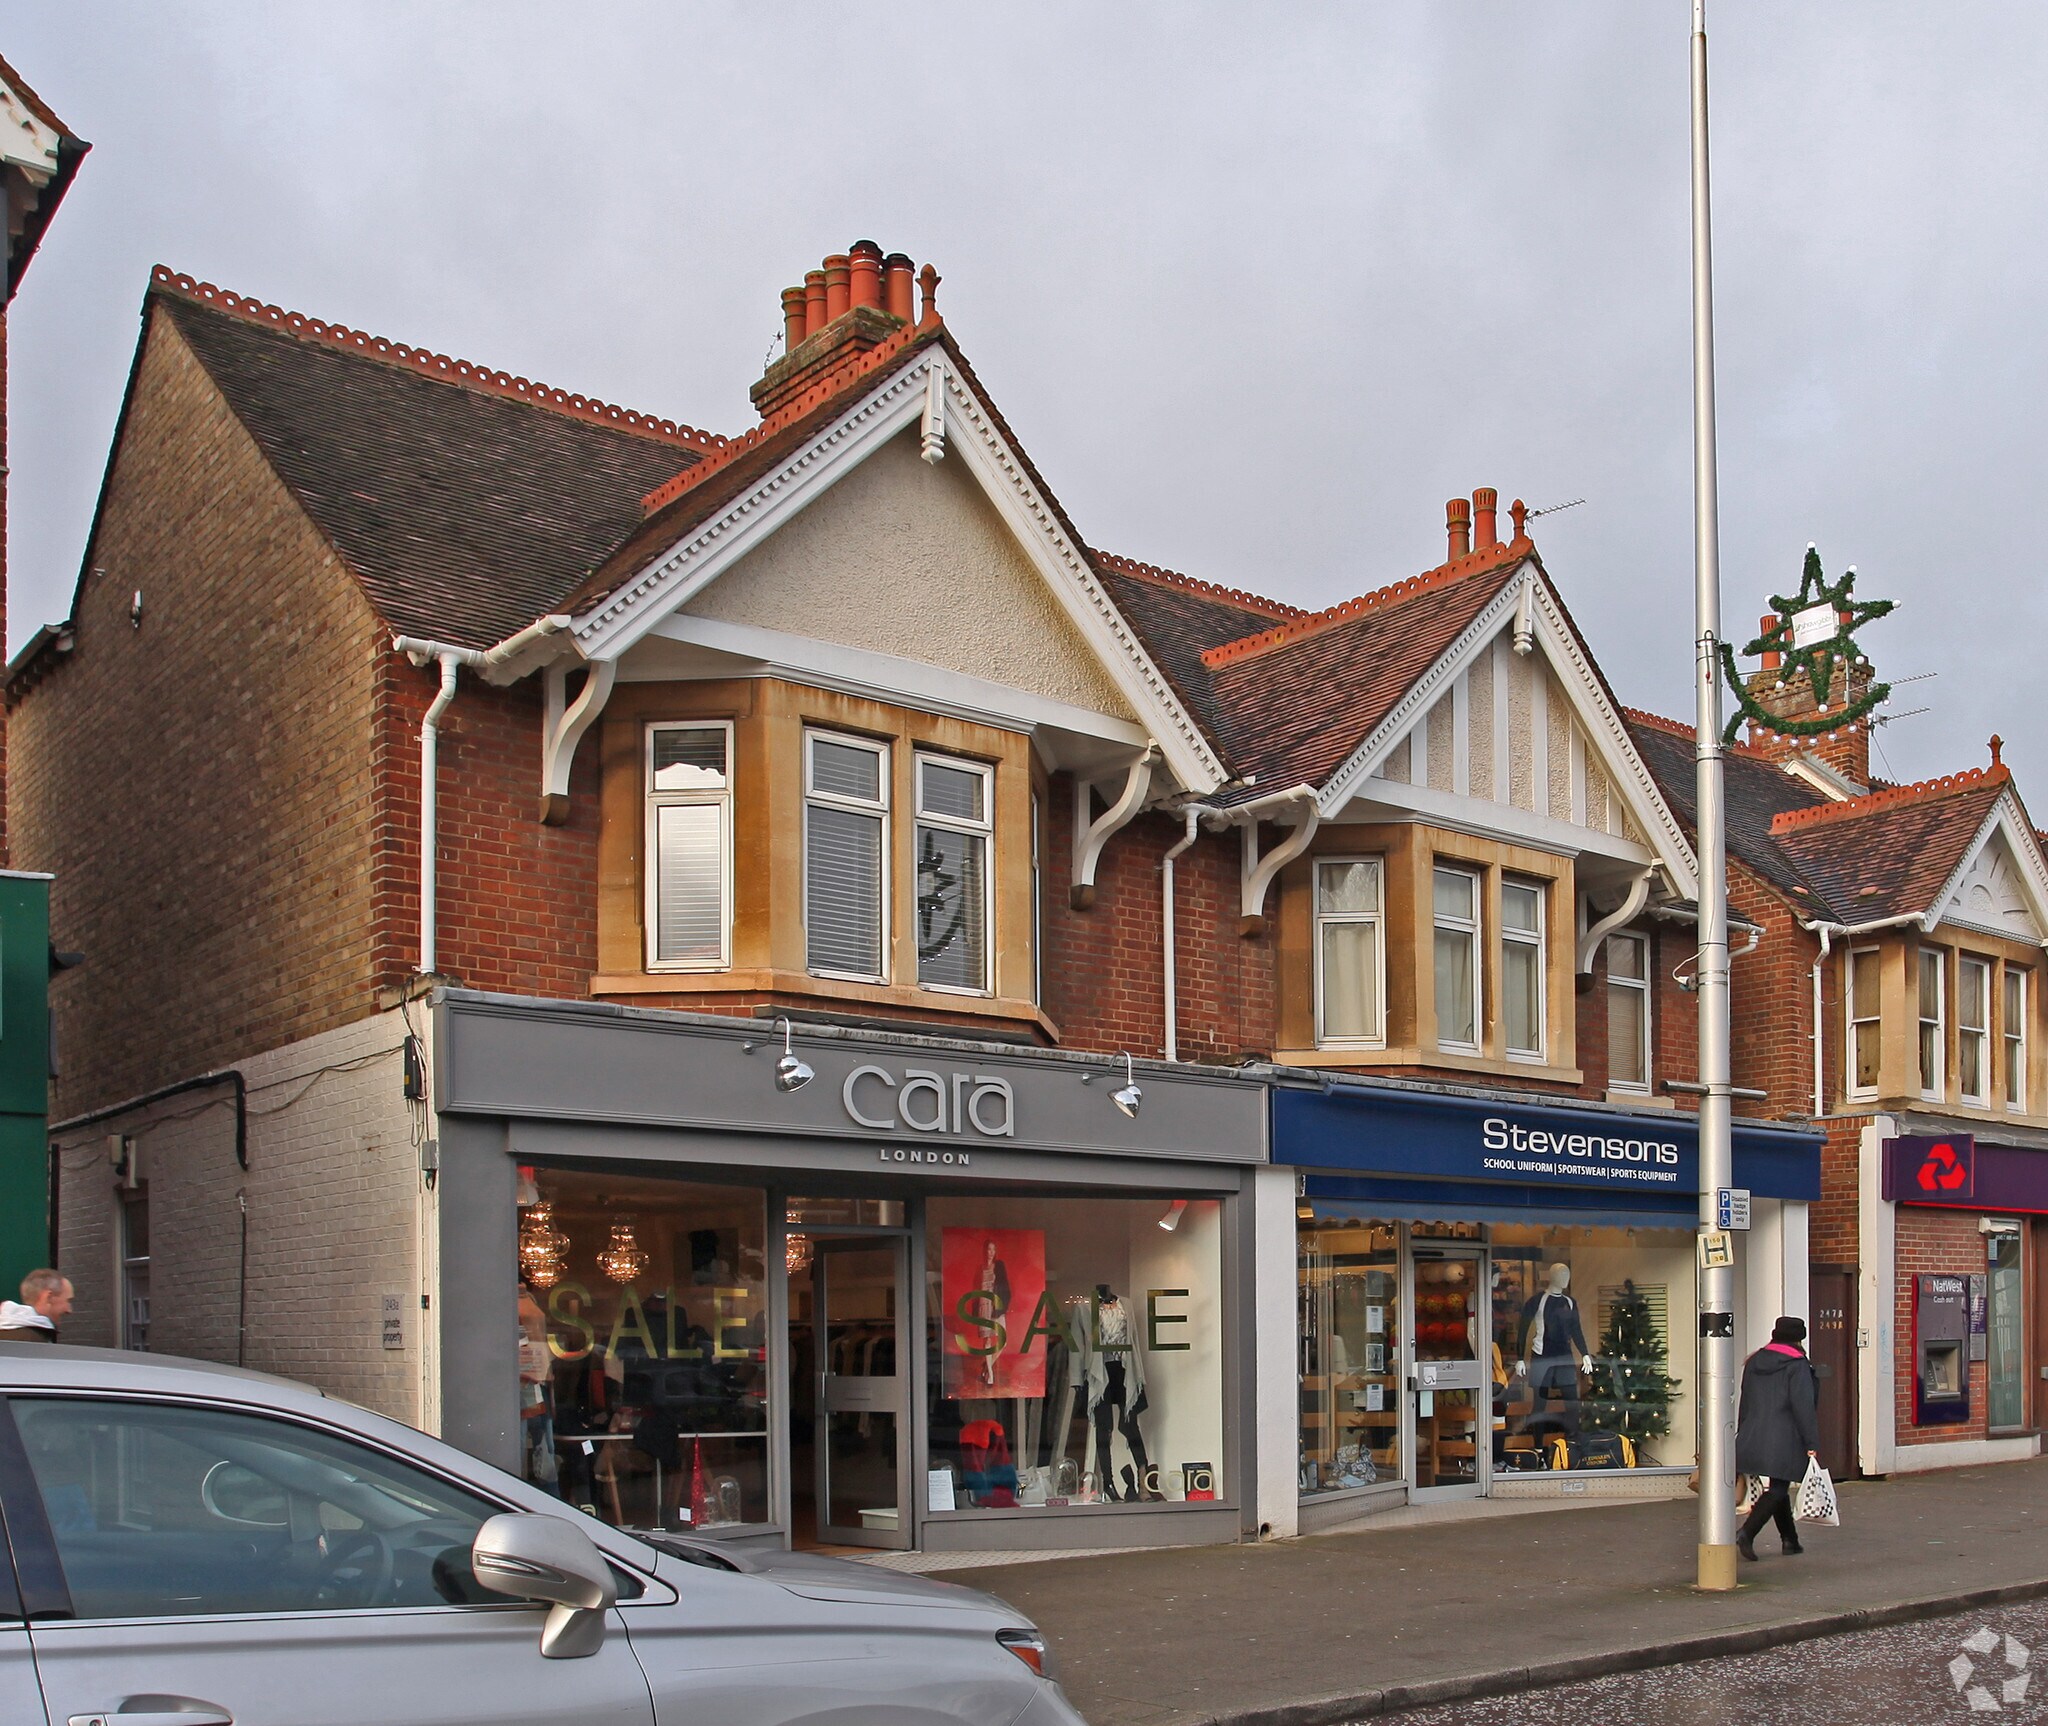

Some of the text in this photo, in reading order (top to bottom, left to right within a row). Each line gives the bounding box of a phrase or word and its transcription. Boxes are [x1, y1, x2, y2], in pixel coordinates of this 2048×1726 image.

[843, 1065, 1014, 1137] cara
[1483, 1118, 1678, 1164] Stevensons
[880, 1149, 969, 1165] LONDON
[1483, 1157, 1678, 1182] SCHOOL UNIFORM SPORTSWEAR SPORTS EQUIPMENT
[1721, 1192, 1729, 1207] P
[1932, 1279, 1963, 1293] NatWest
[546, 1282, 749, 1361] SALE
[954, 1288, 1191, 1356] SALE
[1819, 1309, 1844, 1318] 247A
[1144, 1469, 1213, 1493] cara
